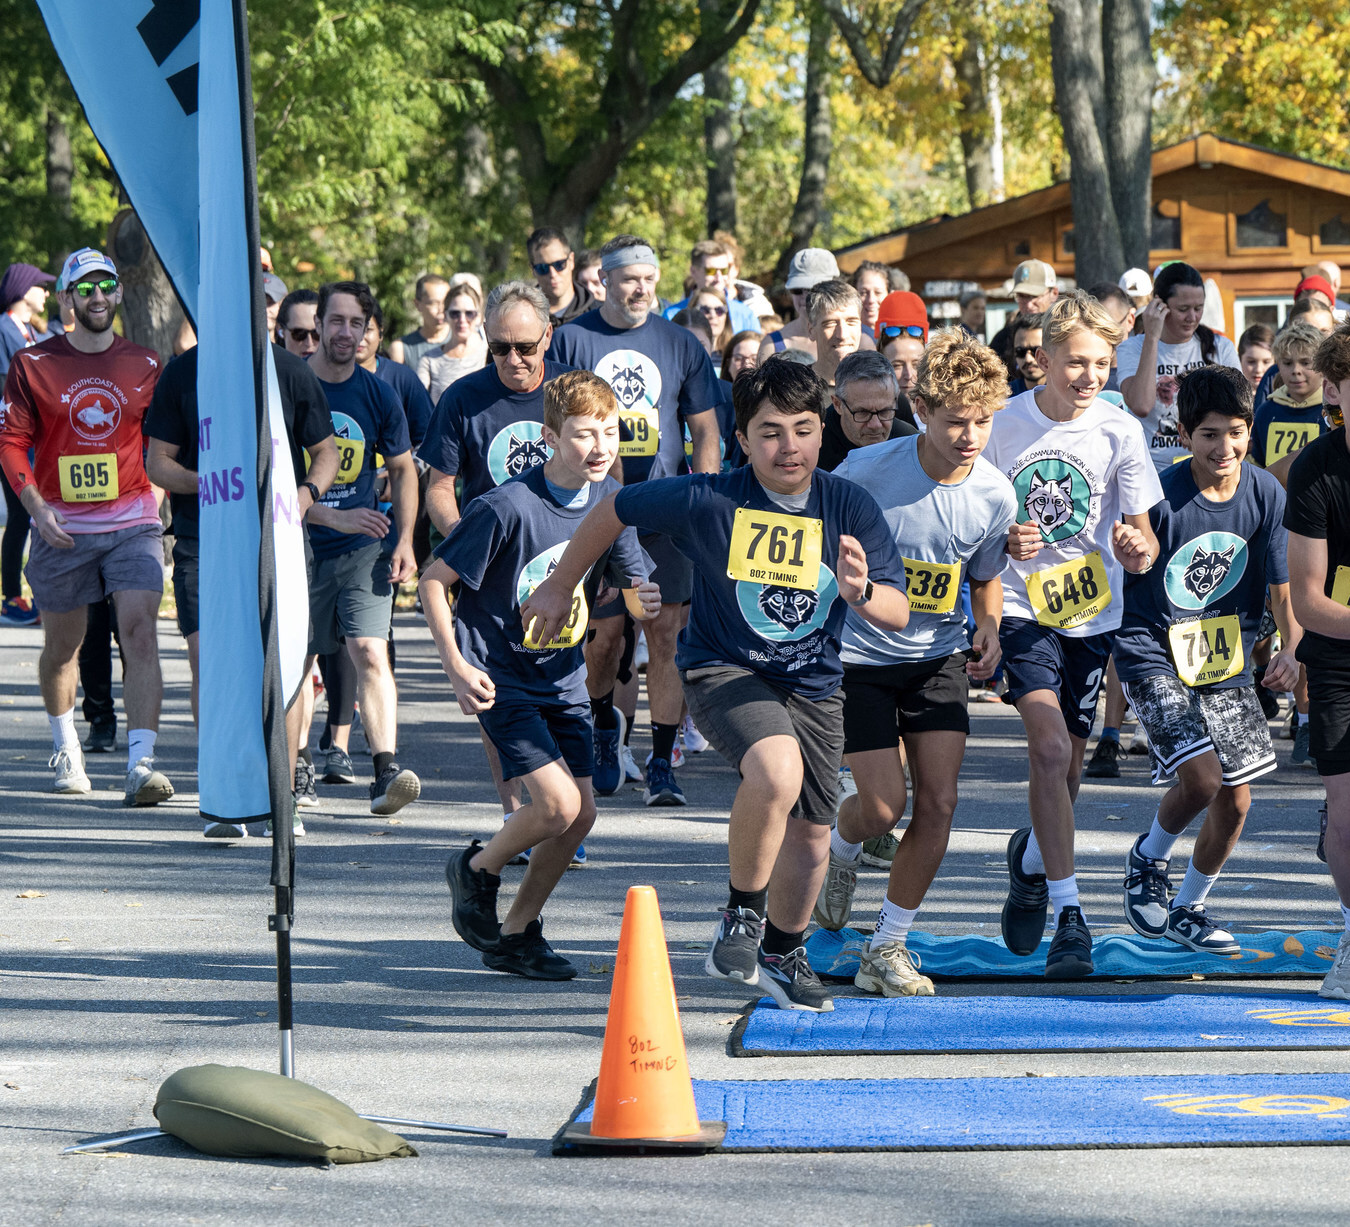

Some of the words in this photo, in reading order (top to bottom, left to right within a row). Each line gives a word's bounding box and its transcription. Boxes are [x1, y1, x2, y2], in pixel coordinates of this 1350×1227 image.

[67, 377, 114, 395] SOUTHCOAST
[113, 385, 129, 405] WIND
[1275, 430, 1309, 454] 724
[70, 462, 109, 489] 695
[87, 491, 107, 499] TIMING
[746, 522, 805, 567] 761
[750, 568, 766, 580] 802
[768, 570, 798, 584] TIMING
[1042, 565, 1099, 615] 648
[911, 601, 938, 611] TIMING
[1058, 616, 1074, 628] 802
[1073, 605, 1099, 622] TIMING
[1182, 627, 1231, 668] 744
[1194, 672, 1206, 682] 802
[1207, 668, 1230, 680] TIMING
[1079, 667, 1103, 709] 2
[1174, 739, 1192, 751] NIKE
[1241, 753, 1261, 767] NIKE
[628, 1034, 660, 1055] 802
